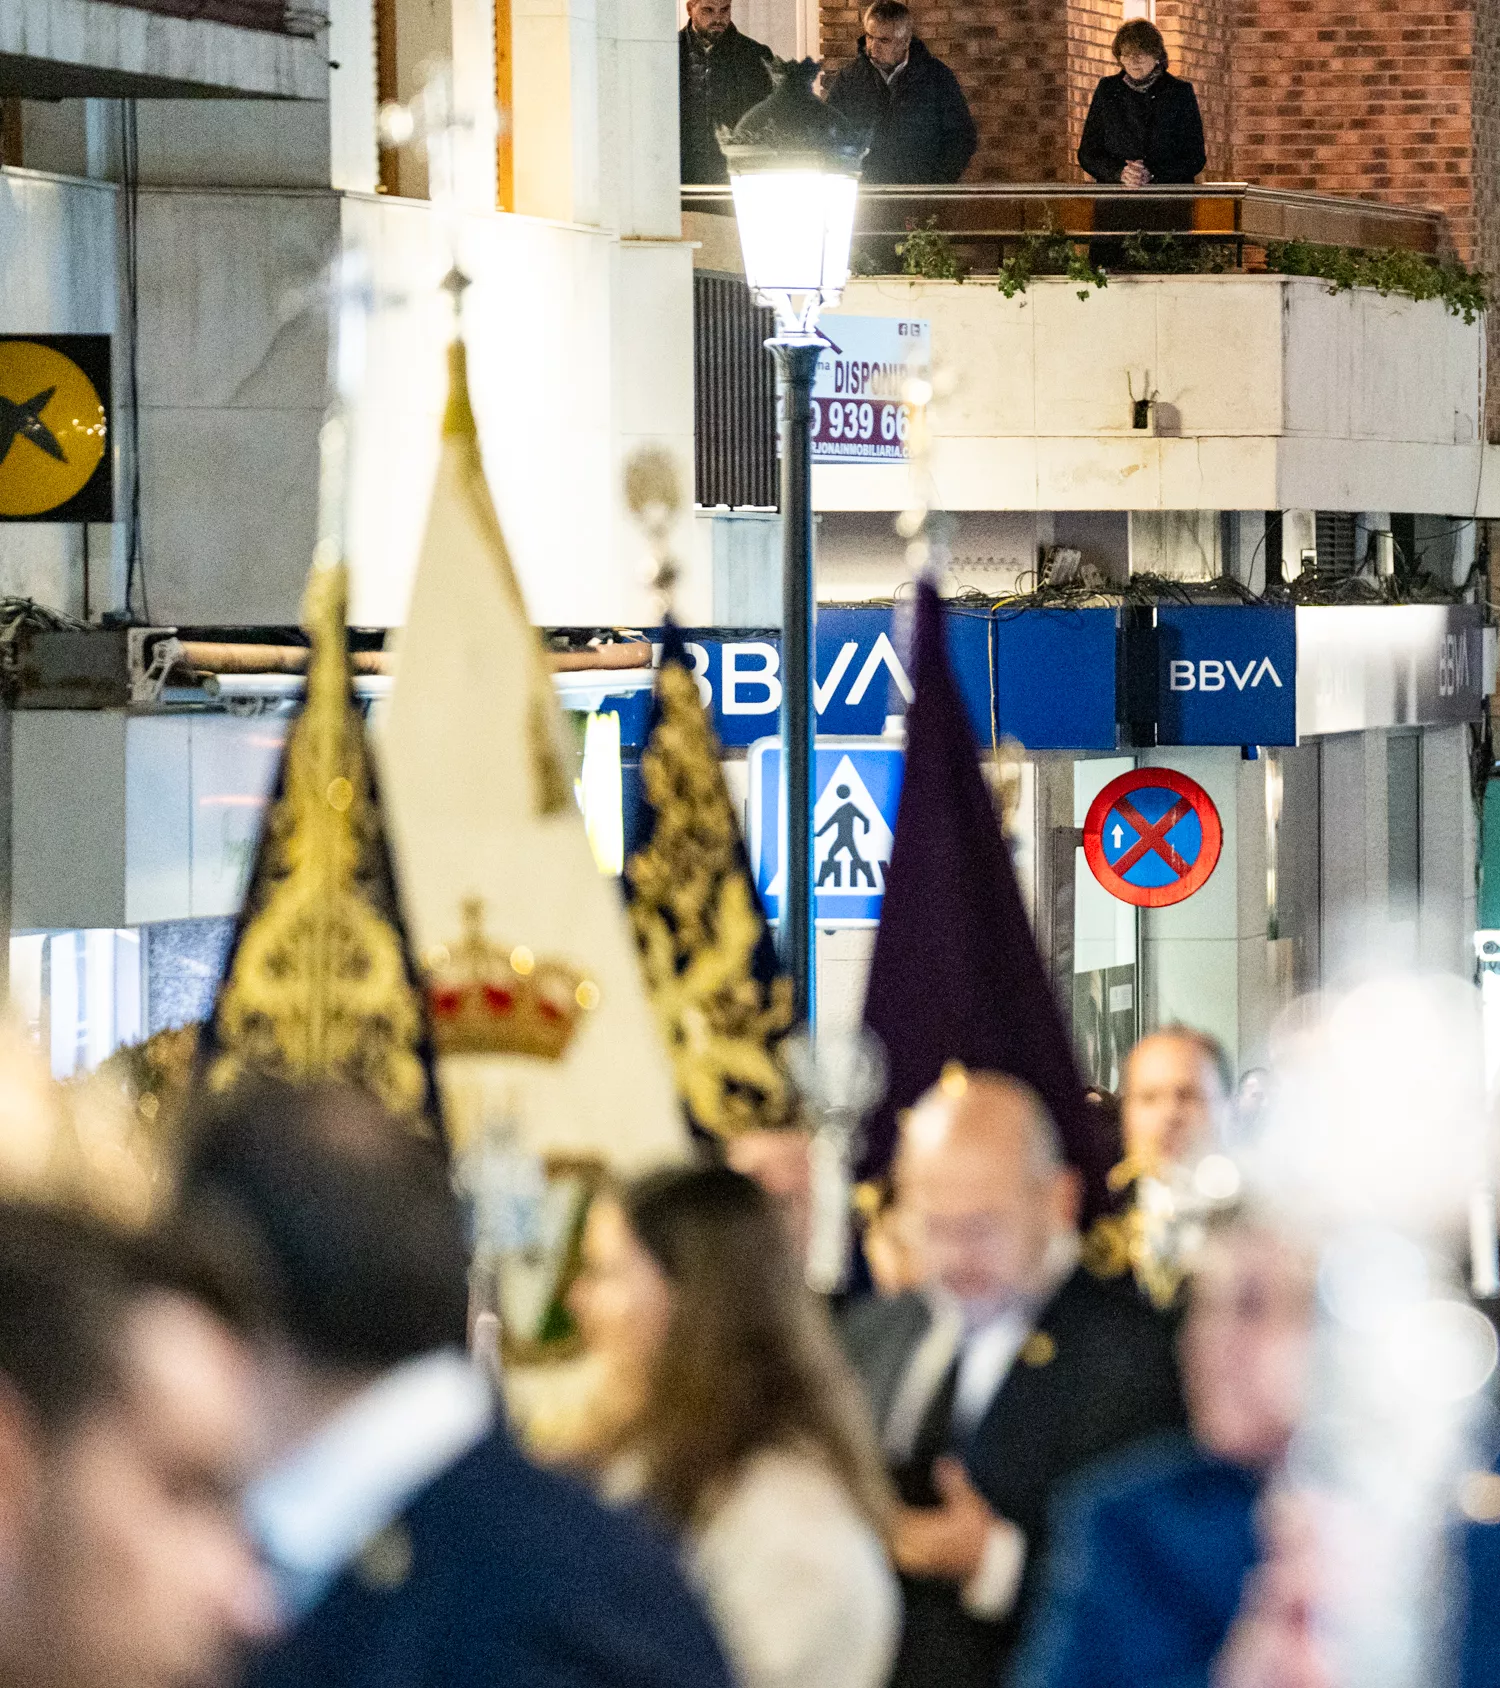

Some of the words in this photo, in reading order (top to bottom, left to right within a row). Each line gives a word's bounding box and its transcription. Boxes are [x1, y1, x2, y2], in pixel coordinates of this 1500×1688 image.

[829, 401, 874, 440] 939
[881, 404, 911, 441] 66
[1170, 656, 1283, 691] BBVA
